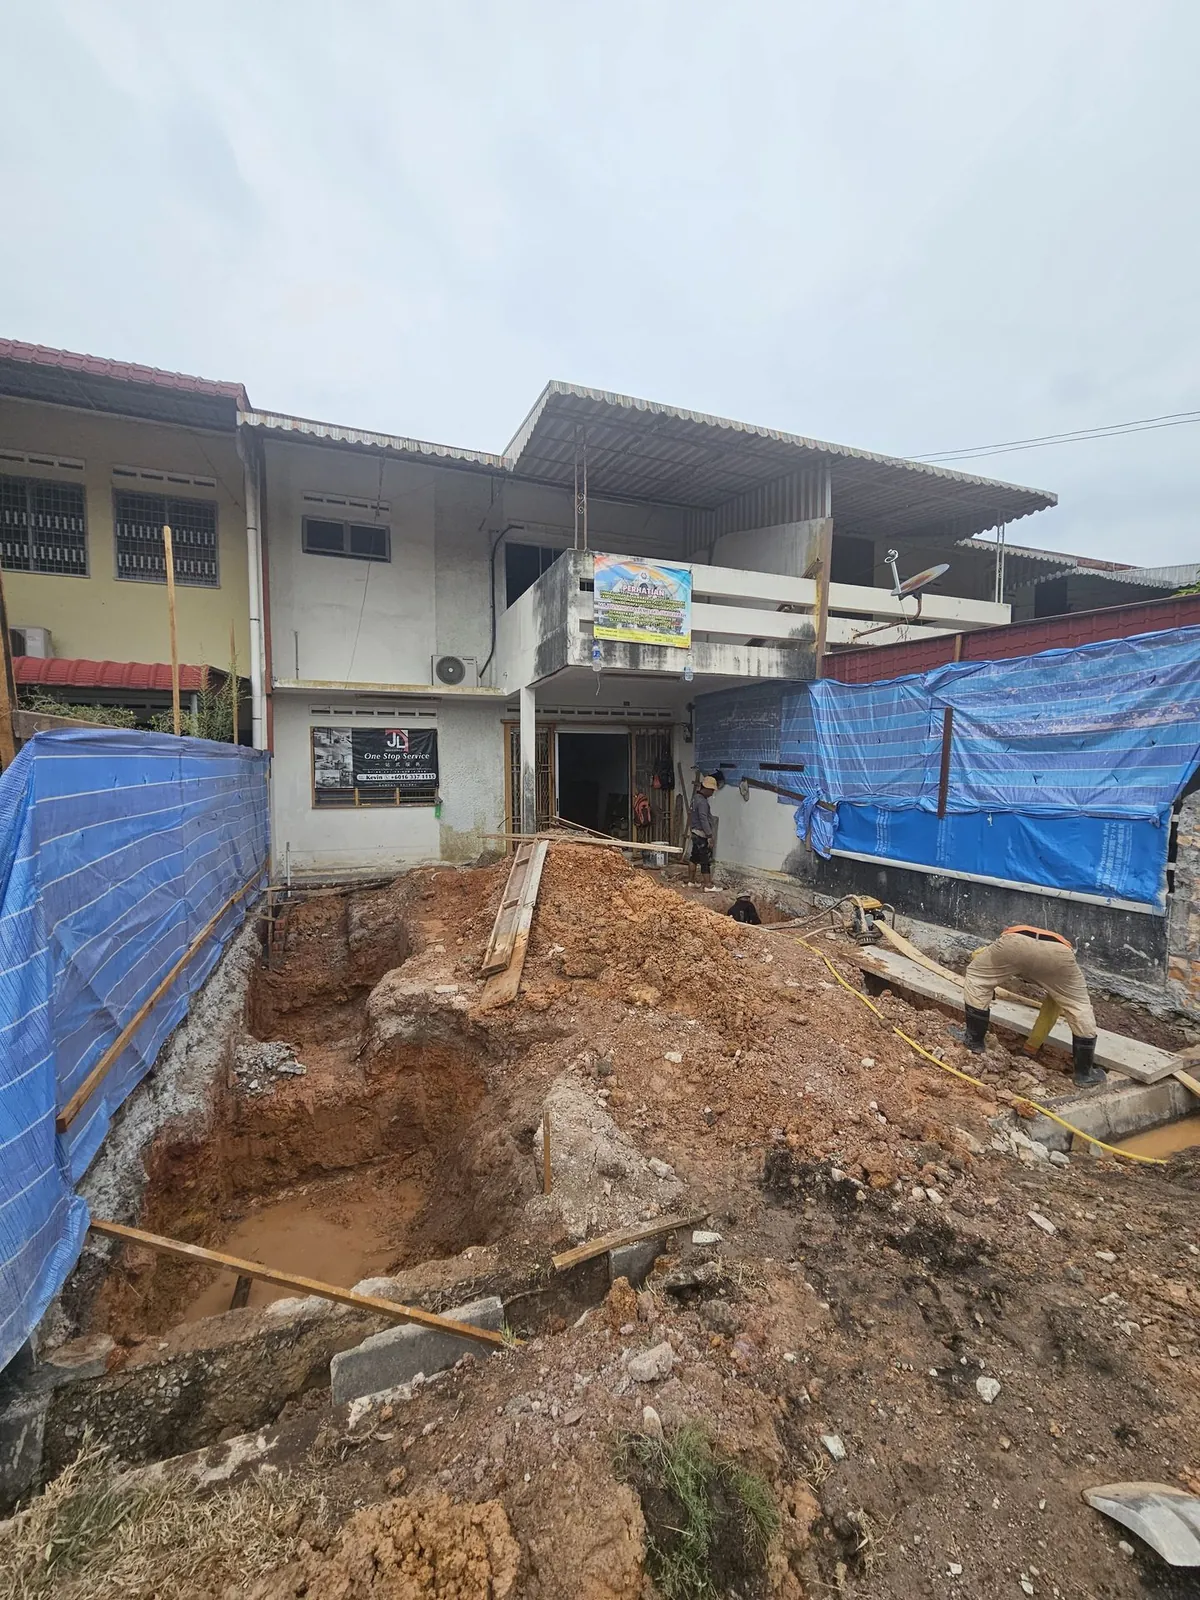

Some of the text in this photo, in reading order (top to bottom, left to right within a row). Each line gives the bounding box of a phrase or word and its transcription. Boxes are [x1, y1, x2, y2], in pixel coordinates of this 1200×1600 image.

[622, 585, 665, 597] PERHATIAN
[387, 732, 406, 748] JL
[364, 752, 430, 761] One Stop Service
